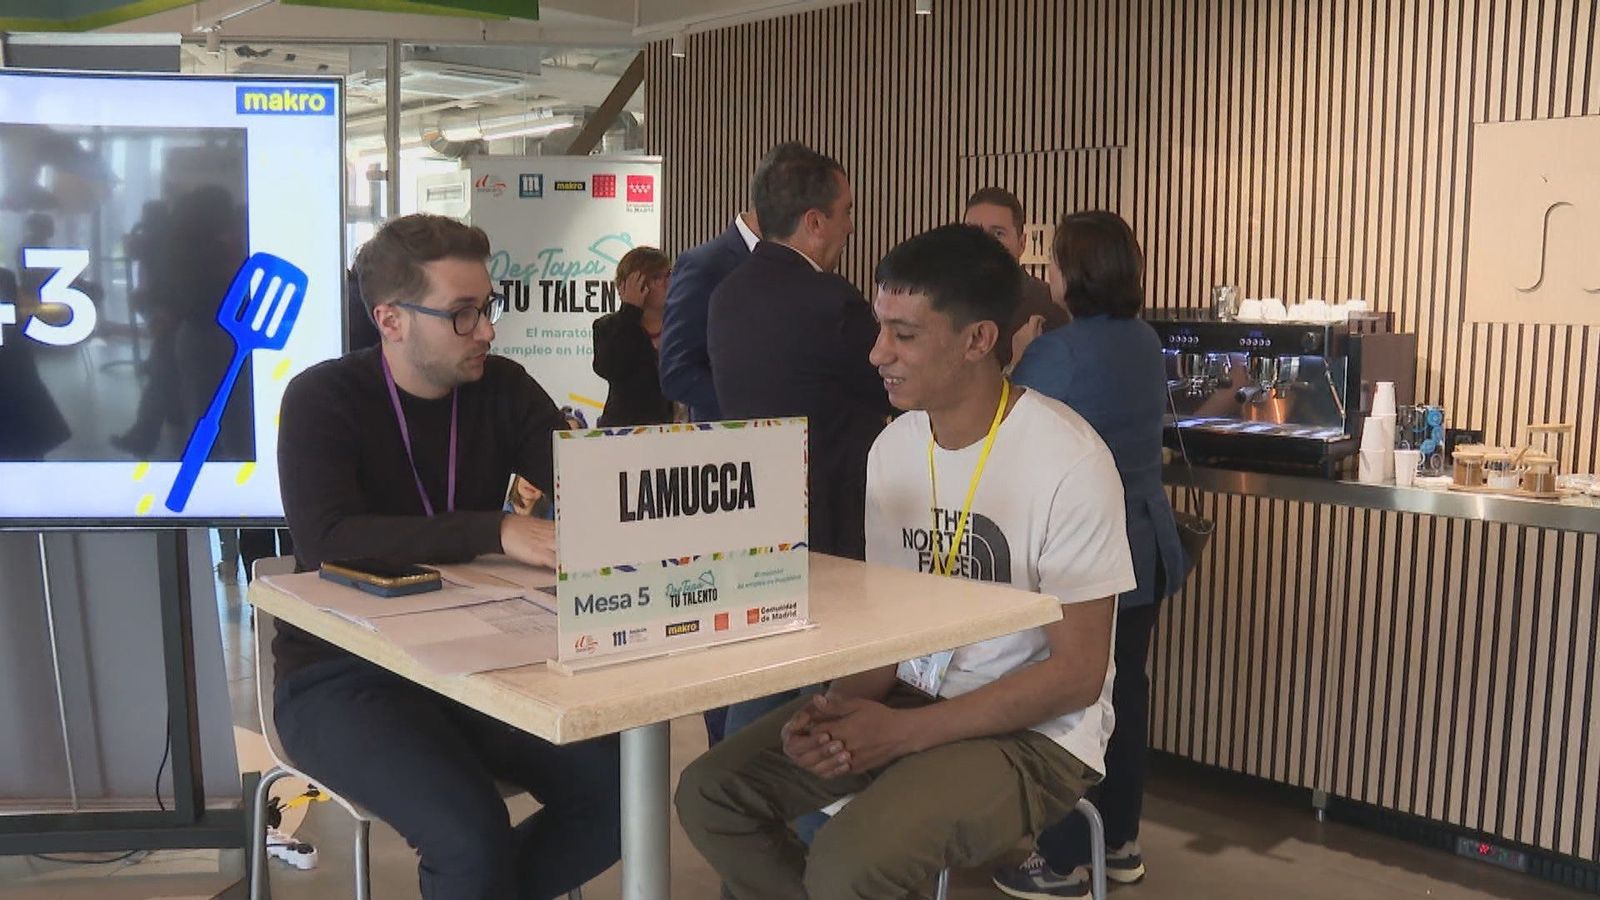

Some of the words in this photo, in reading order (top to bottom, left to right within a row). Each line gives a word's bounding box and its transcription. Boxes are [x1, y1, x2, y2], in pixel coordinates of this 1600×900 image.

[244, 89, 326, 111] makro
[499, 280, 530, 312] TU
[539, 280, 616, 312] TALEN
[526, 327, 537, 338] El
[503, 344, 552, 357] empleo
[556, 346, 571, 355] en
[619, 461, 755, 522] LAMUCCA
[902, 527, 970, 556] NORTH
[919, 551, 970, 579] FACE
[575, 593, 632, 616] Mesa
[638, 586, 650, 606] 5
[670, 593, 681, 608] TU
[682, 587, 718, 606] TALENTO
[761, 602, 797, 614] Comunidad
[761, 615, 770, 623] de
[772, 610, 797, 620] Madrid
[668, 622, 697, 635] makro
